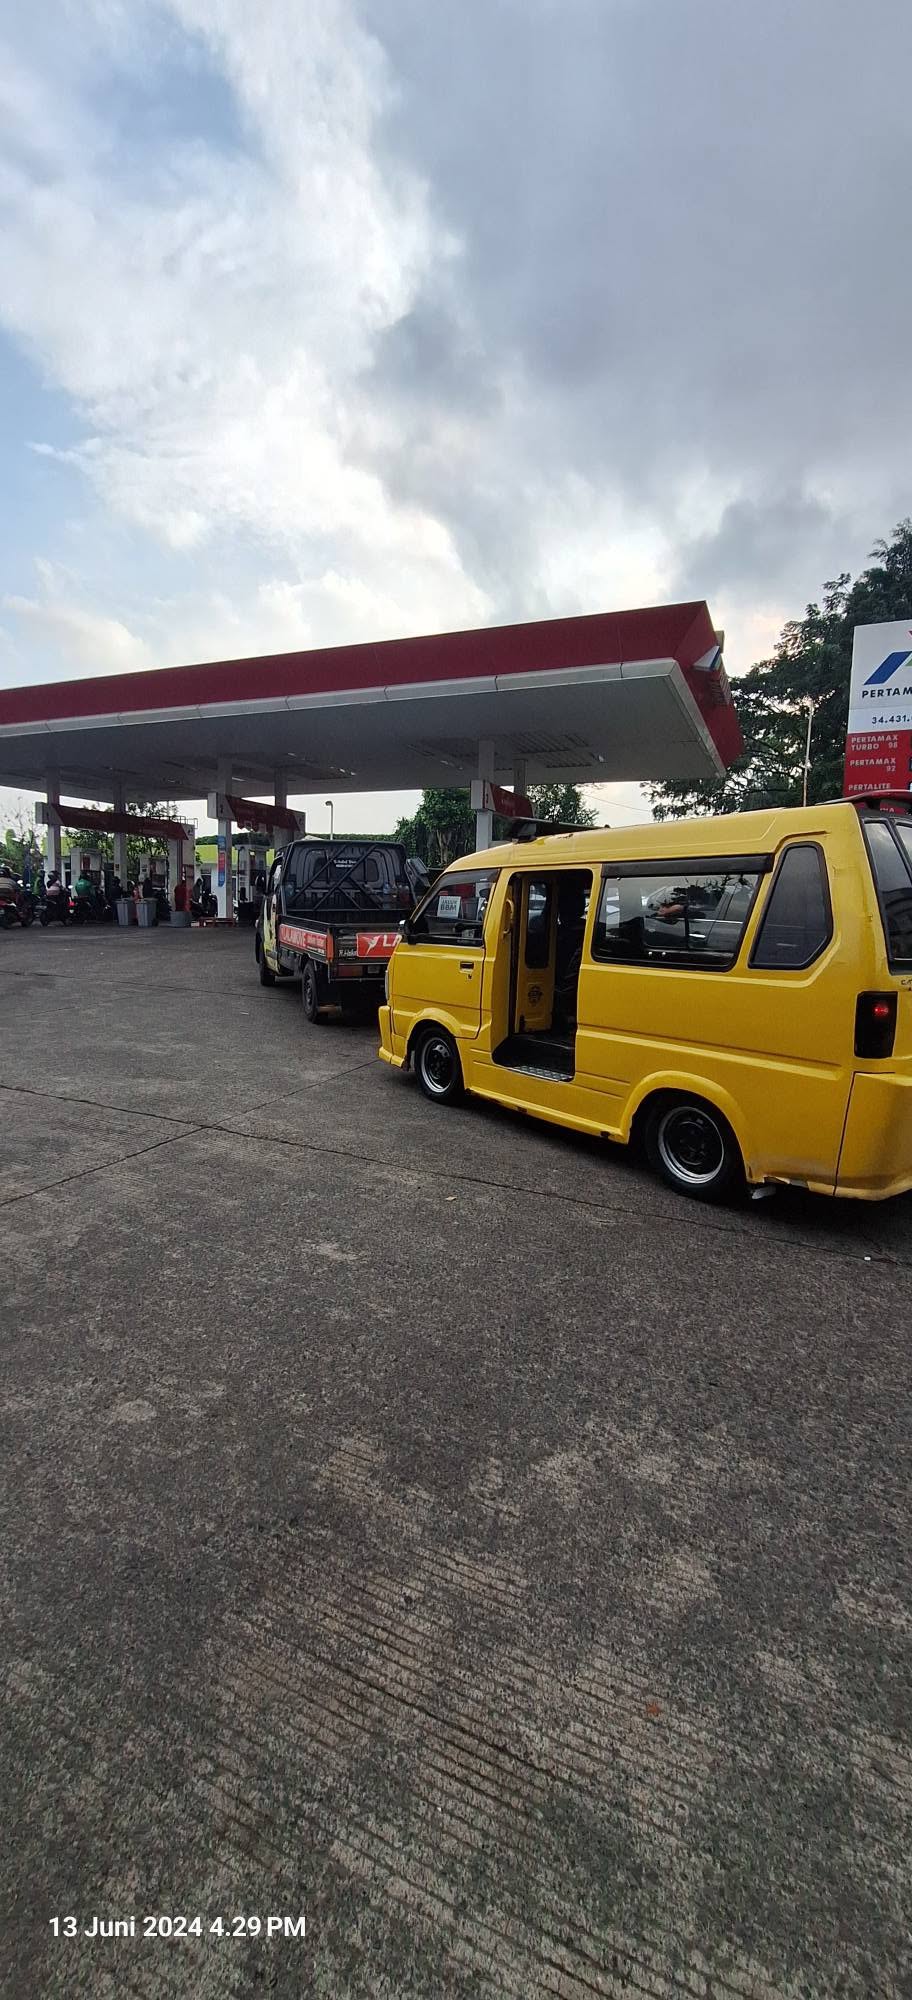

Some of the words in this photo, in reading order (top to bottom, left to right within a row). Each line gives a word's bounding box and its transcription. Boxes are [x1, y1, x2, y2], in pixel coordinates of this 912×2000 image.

[871, 715, 912, 724] 34.431.
[851, 734, 899, 744] PERTAMAX
[851, 743, 880, 751] TURBO
[849, 757, 896, 767] PERTAMAX
[848, 783, 891, 791] PERTALITE
